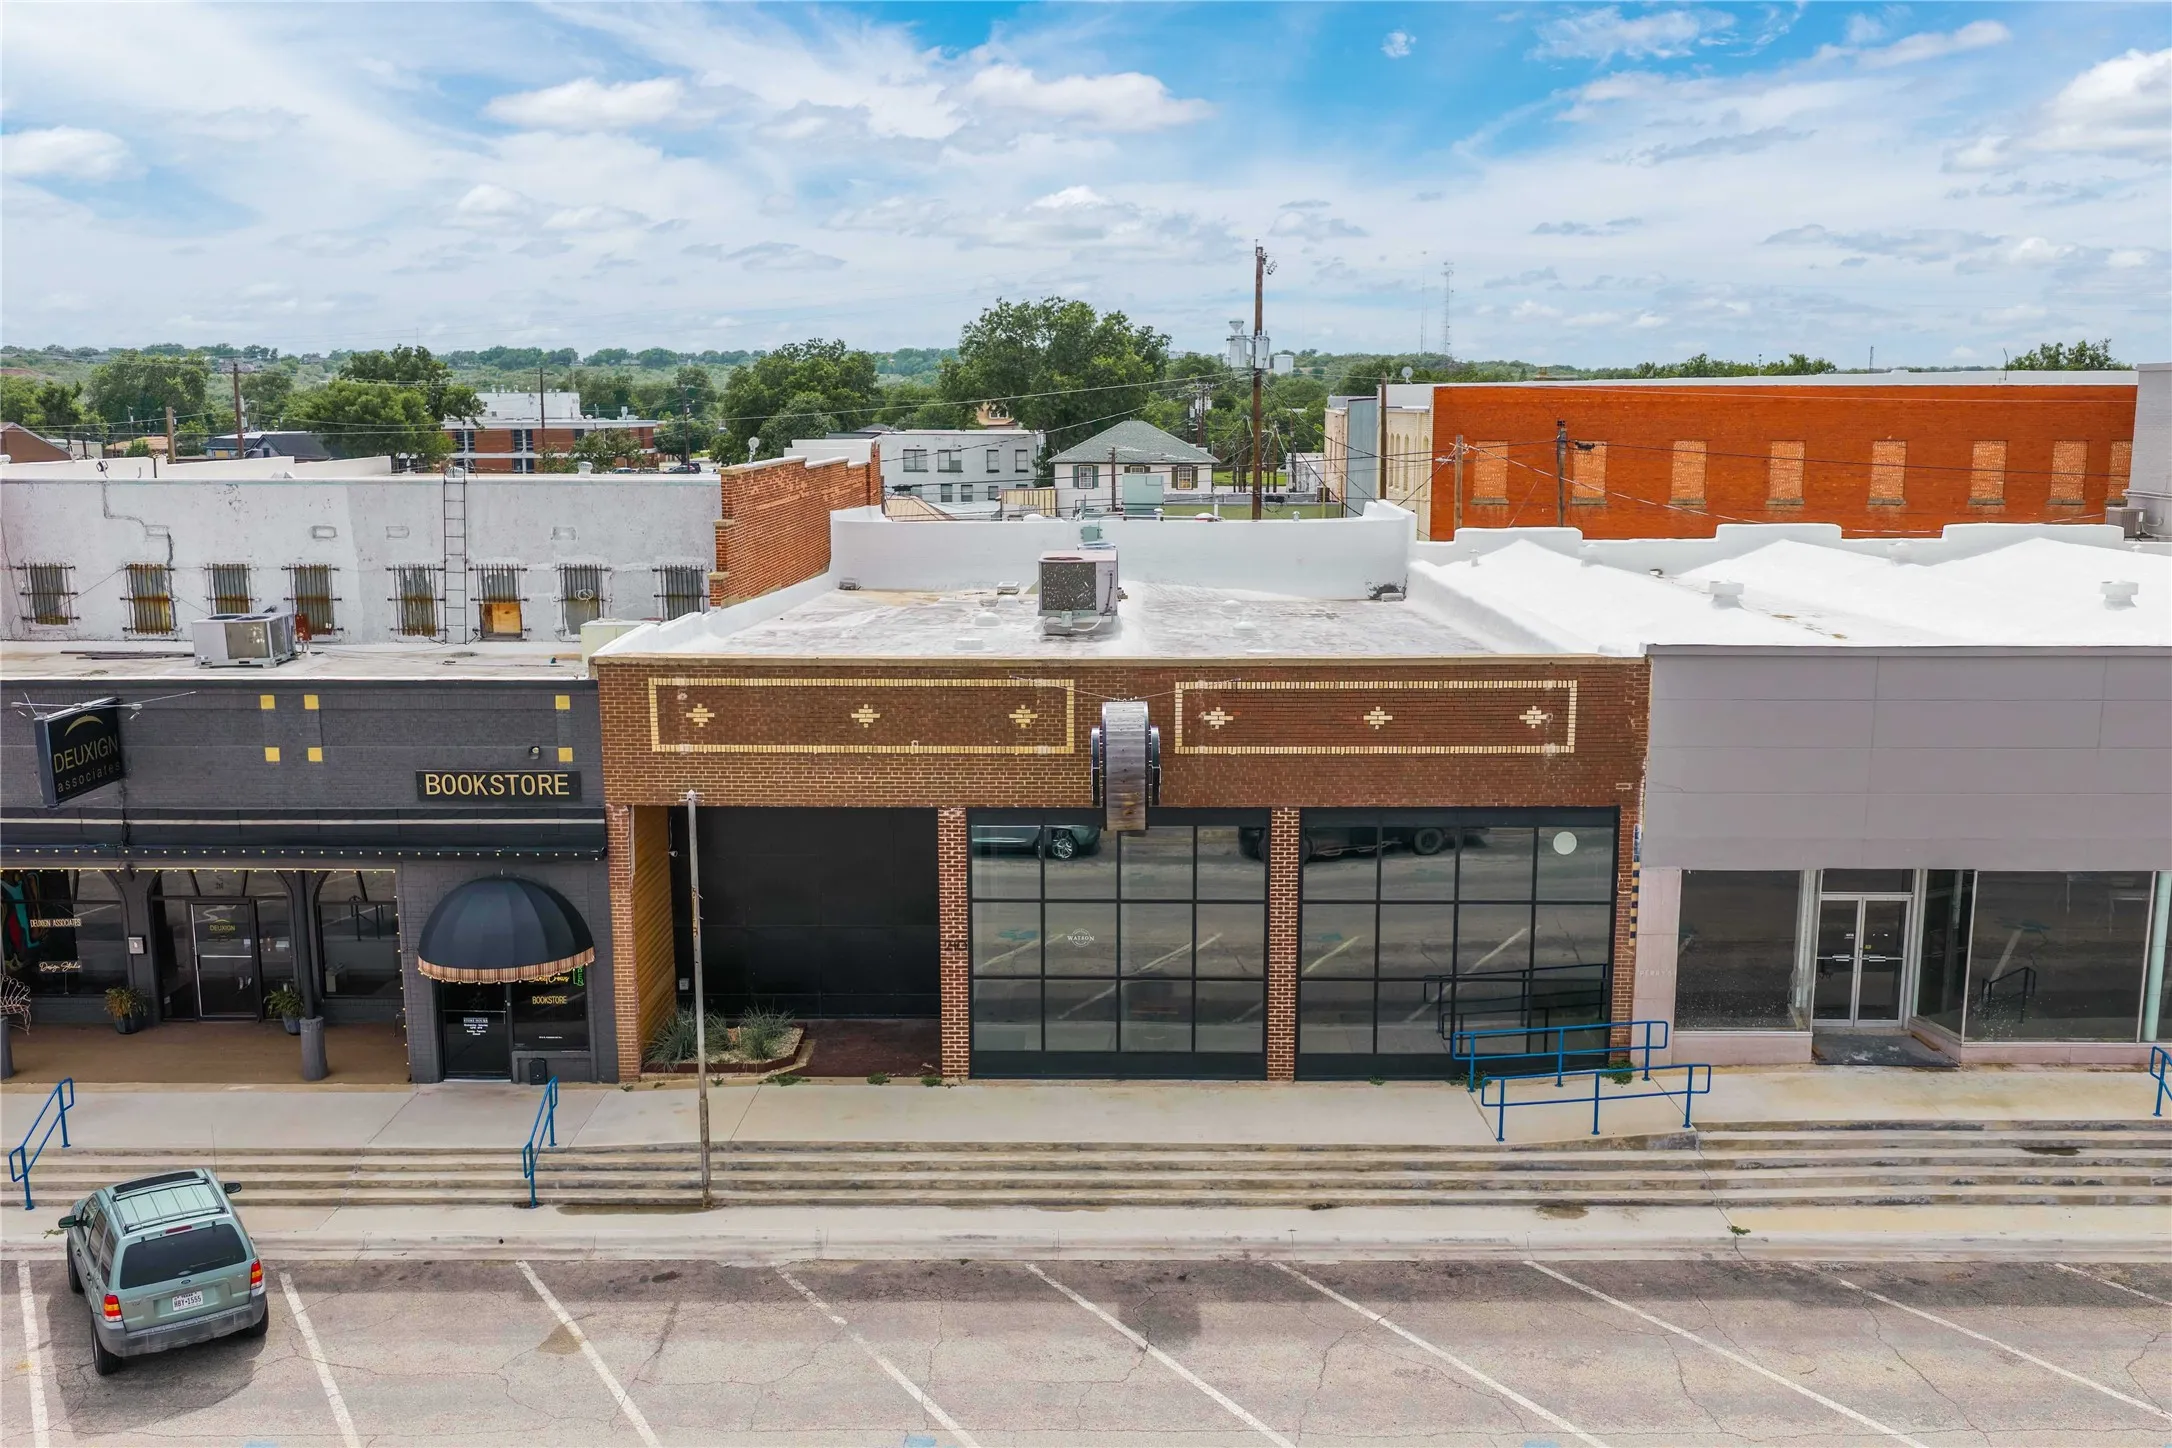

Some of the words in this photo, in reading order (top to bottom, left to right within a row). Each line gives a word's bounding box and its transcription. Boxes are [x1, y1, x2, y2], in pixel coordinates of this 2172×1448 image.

[54, 734, 118, 773] DEUXIGN
[58, 762, 120, 792] associates
[425, 774, 570, 796] BOOKSTORE
[53, 918, 81, 928] ASSOCIATES
[531, 995, 568, 1005] BOOKSTORE
